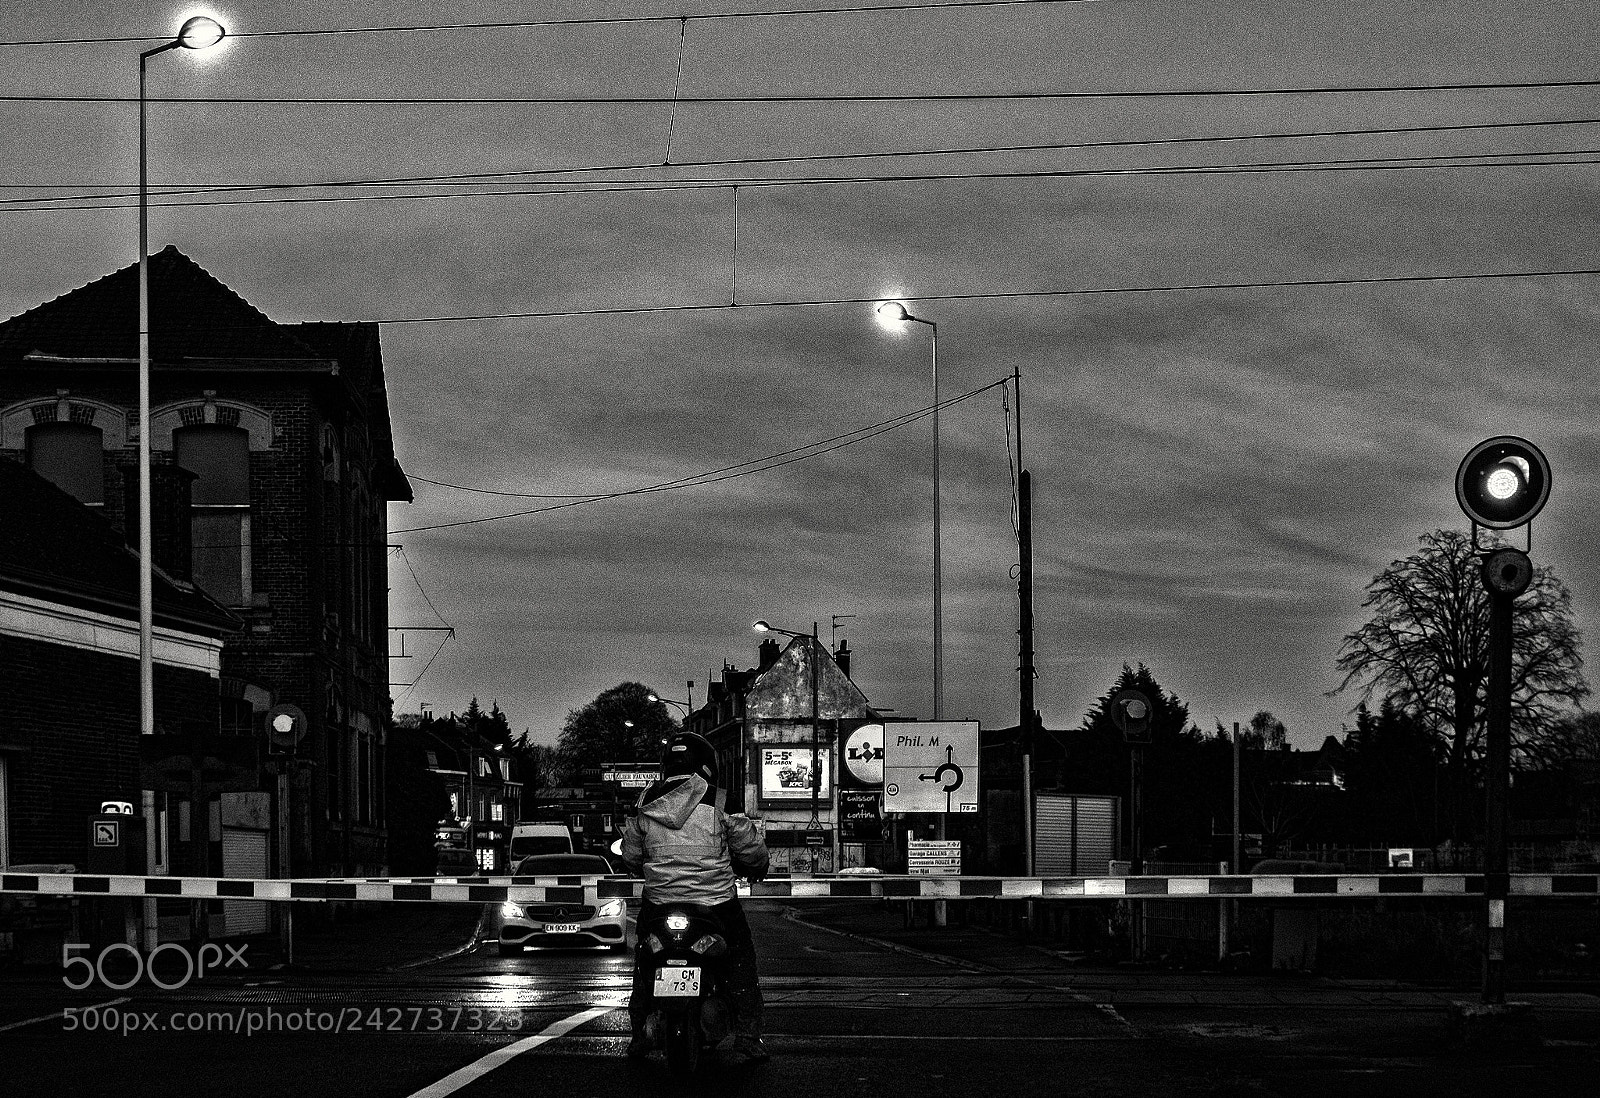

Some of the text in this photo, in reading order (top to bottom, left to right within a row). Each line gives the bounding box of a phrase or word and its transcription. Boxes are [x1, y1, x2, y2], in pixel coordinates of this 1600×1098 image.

[897, 735, 940, 747] Phil. M
[681, 970, 695, 980] CM
[673, 981, 699, 991] 73 S
